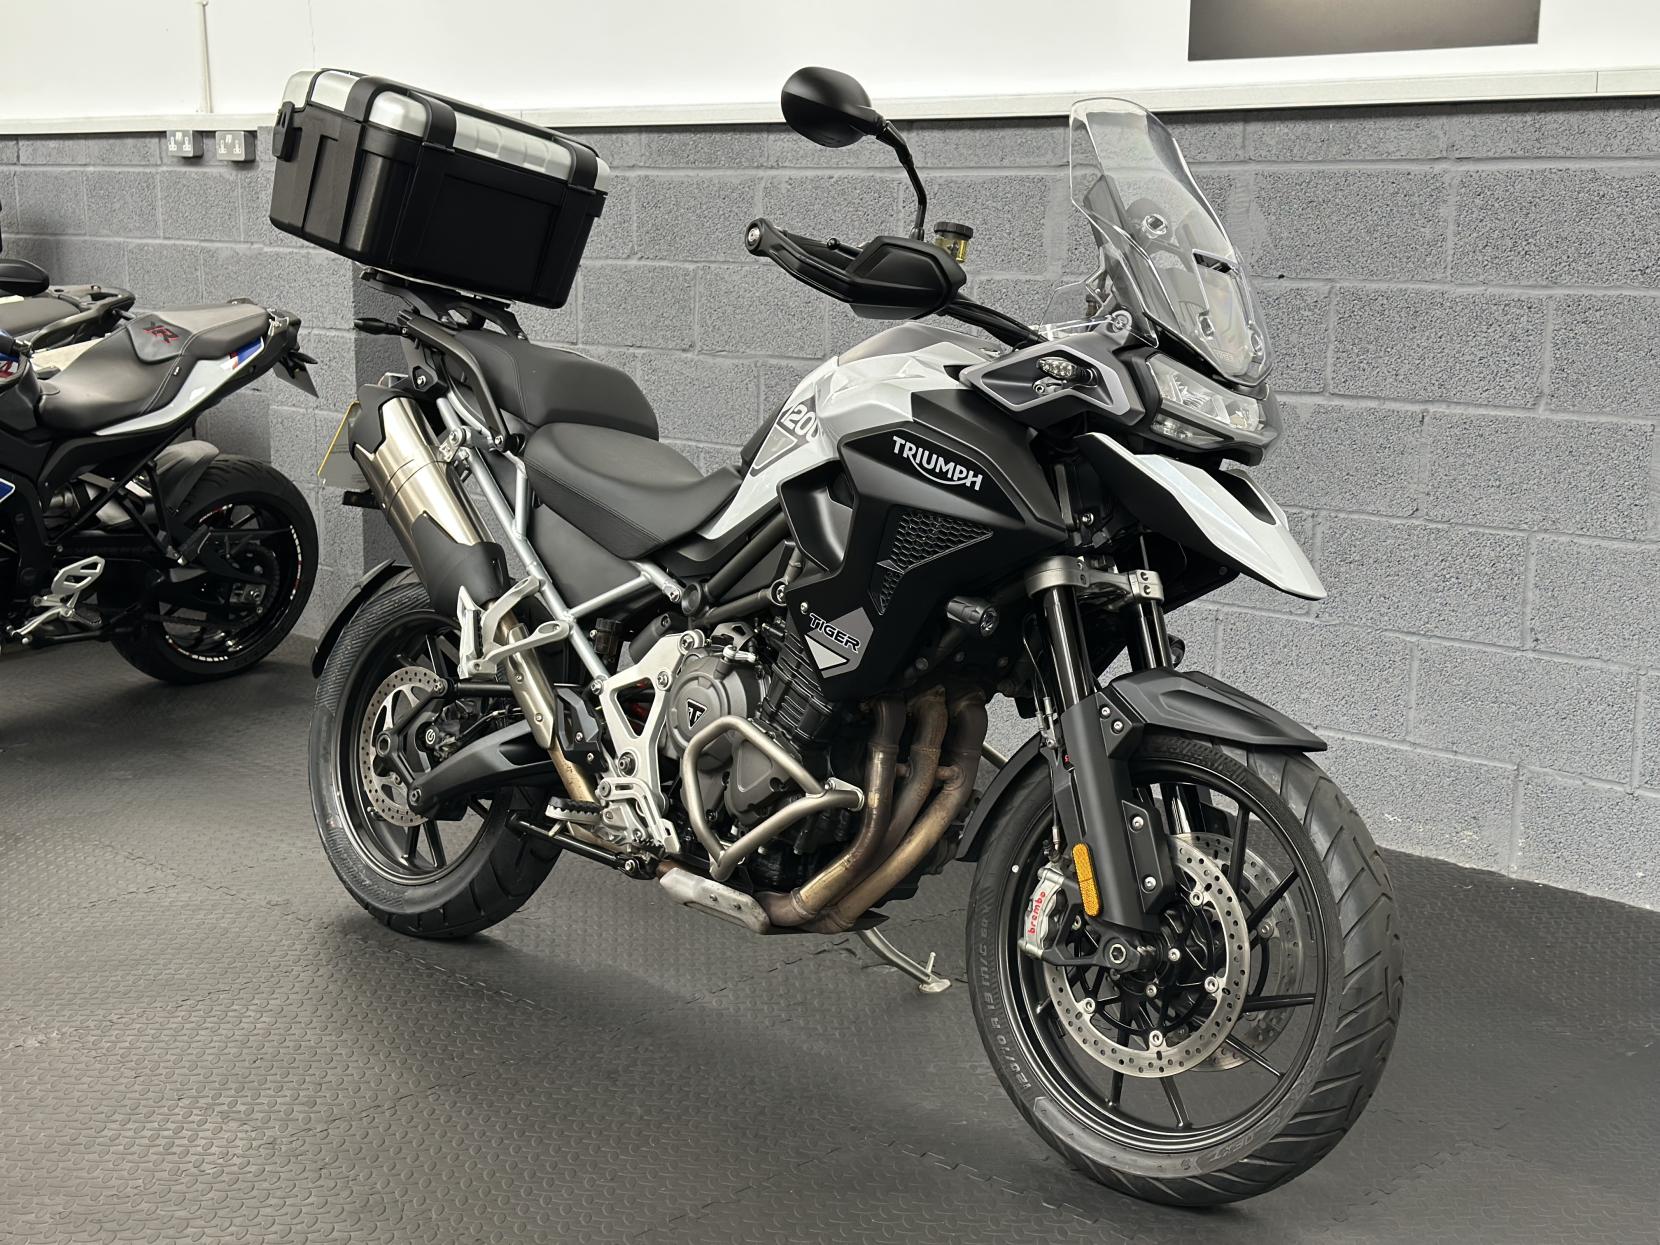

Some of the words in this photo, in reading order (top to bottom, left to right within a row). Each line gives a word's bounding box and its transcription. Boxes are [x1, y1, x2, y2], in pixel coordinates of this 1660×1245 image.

[892, 435, 984, 491] TRIUMPH
[808, 612, 861, 654] TIGER
[1027, 890, 1046, 935] brembo
